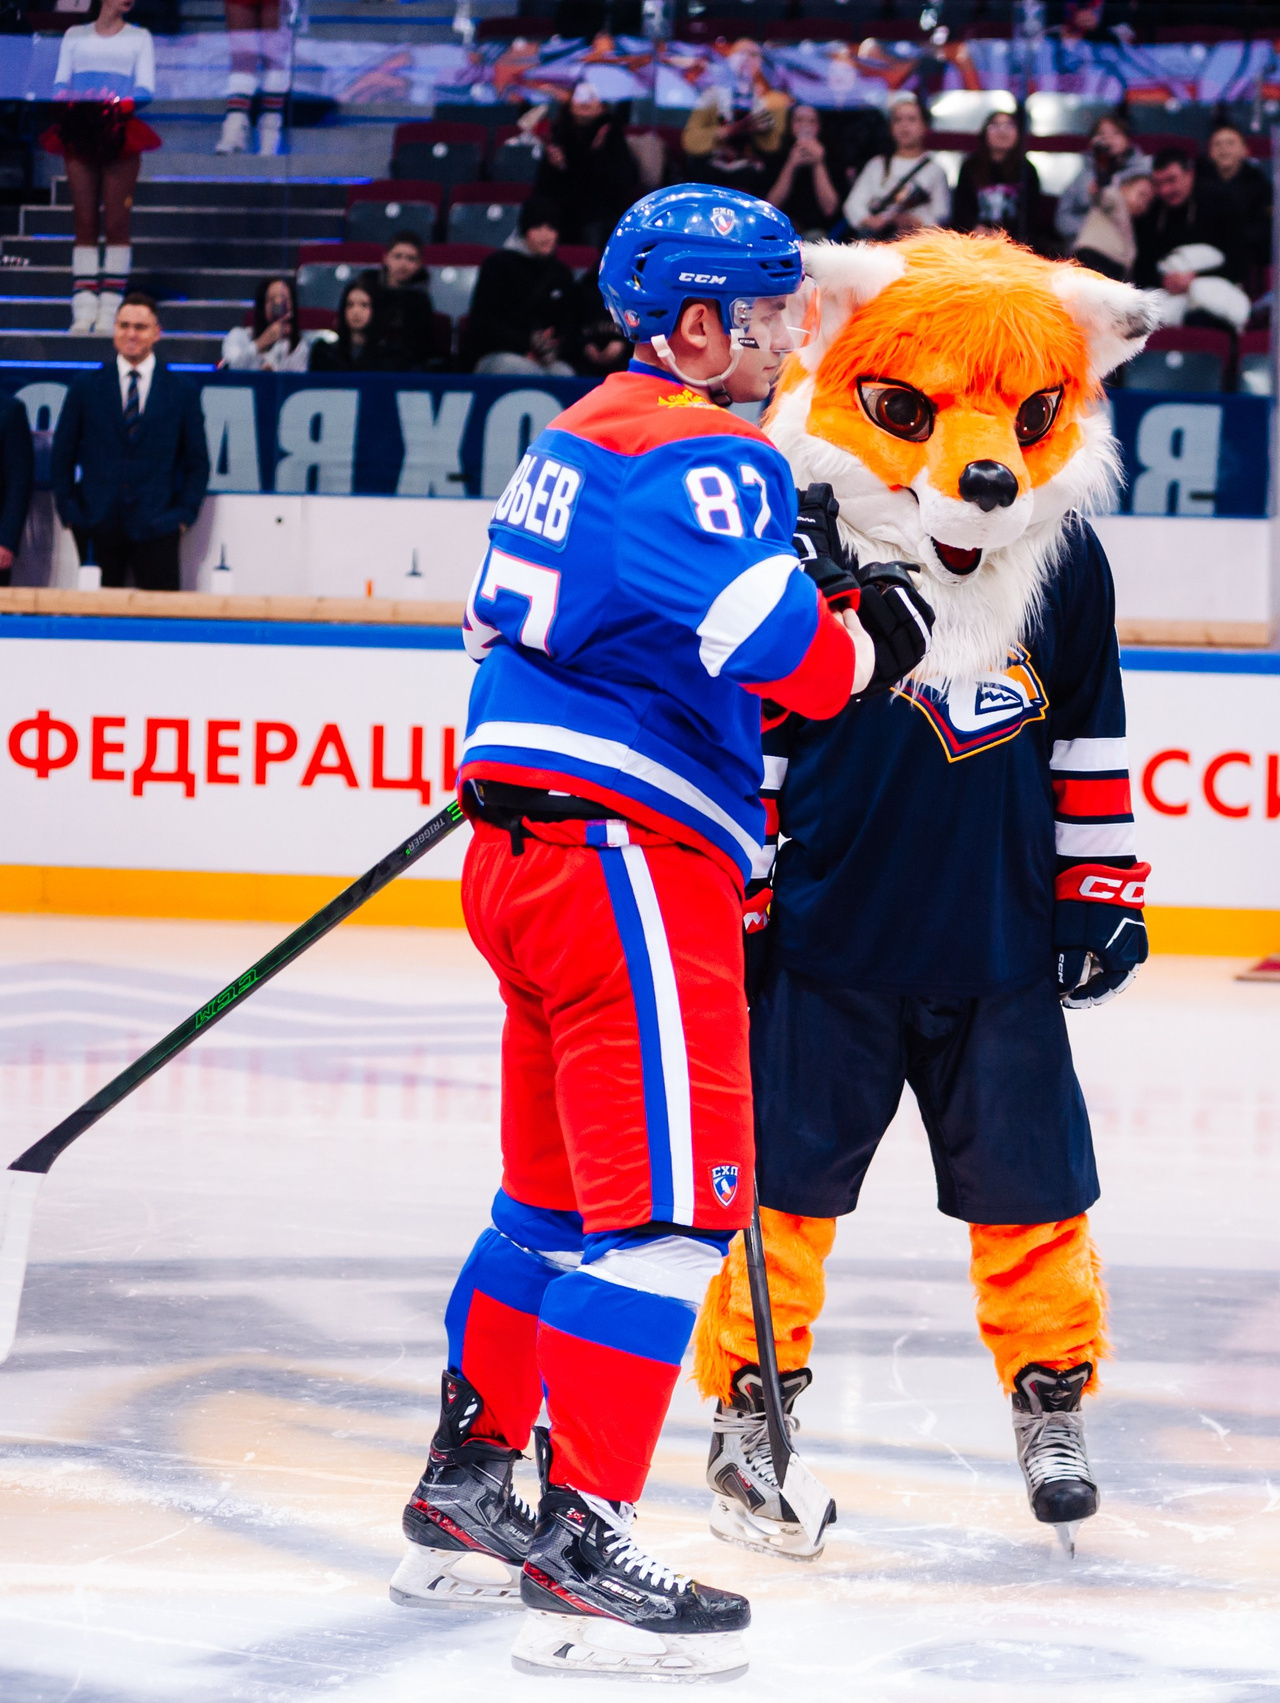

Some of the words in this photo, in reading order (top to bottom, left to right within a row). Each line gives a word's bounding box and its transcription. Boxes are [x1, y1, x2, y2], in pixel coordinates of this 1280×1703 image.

[678, 272, 727, 285] CCM
[491, 453, 580, 542] ВЬЕВ
[685, 464, 772, 539] 87
[1079, 875, 1145, 903] CC
[195, 968, 260, 1029] CCM
